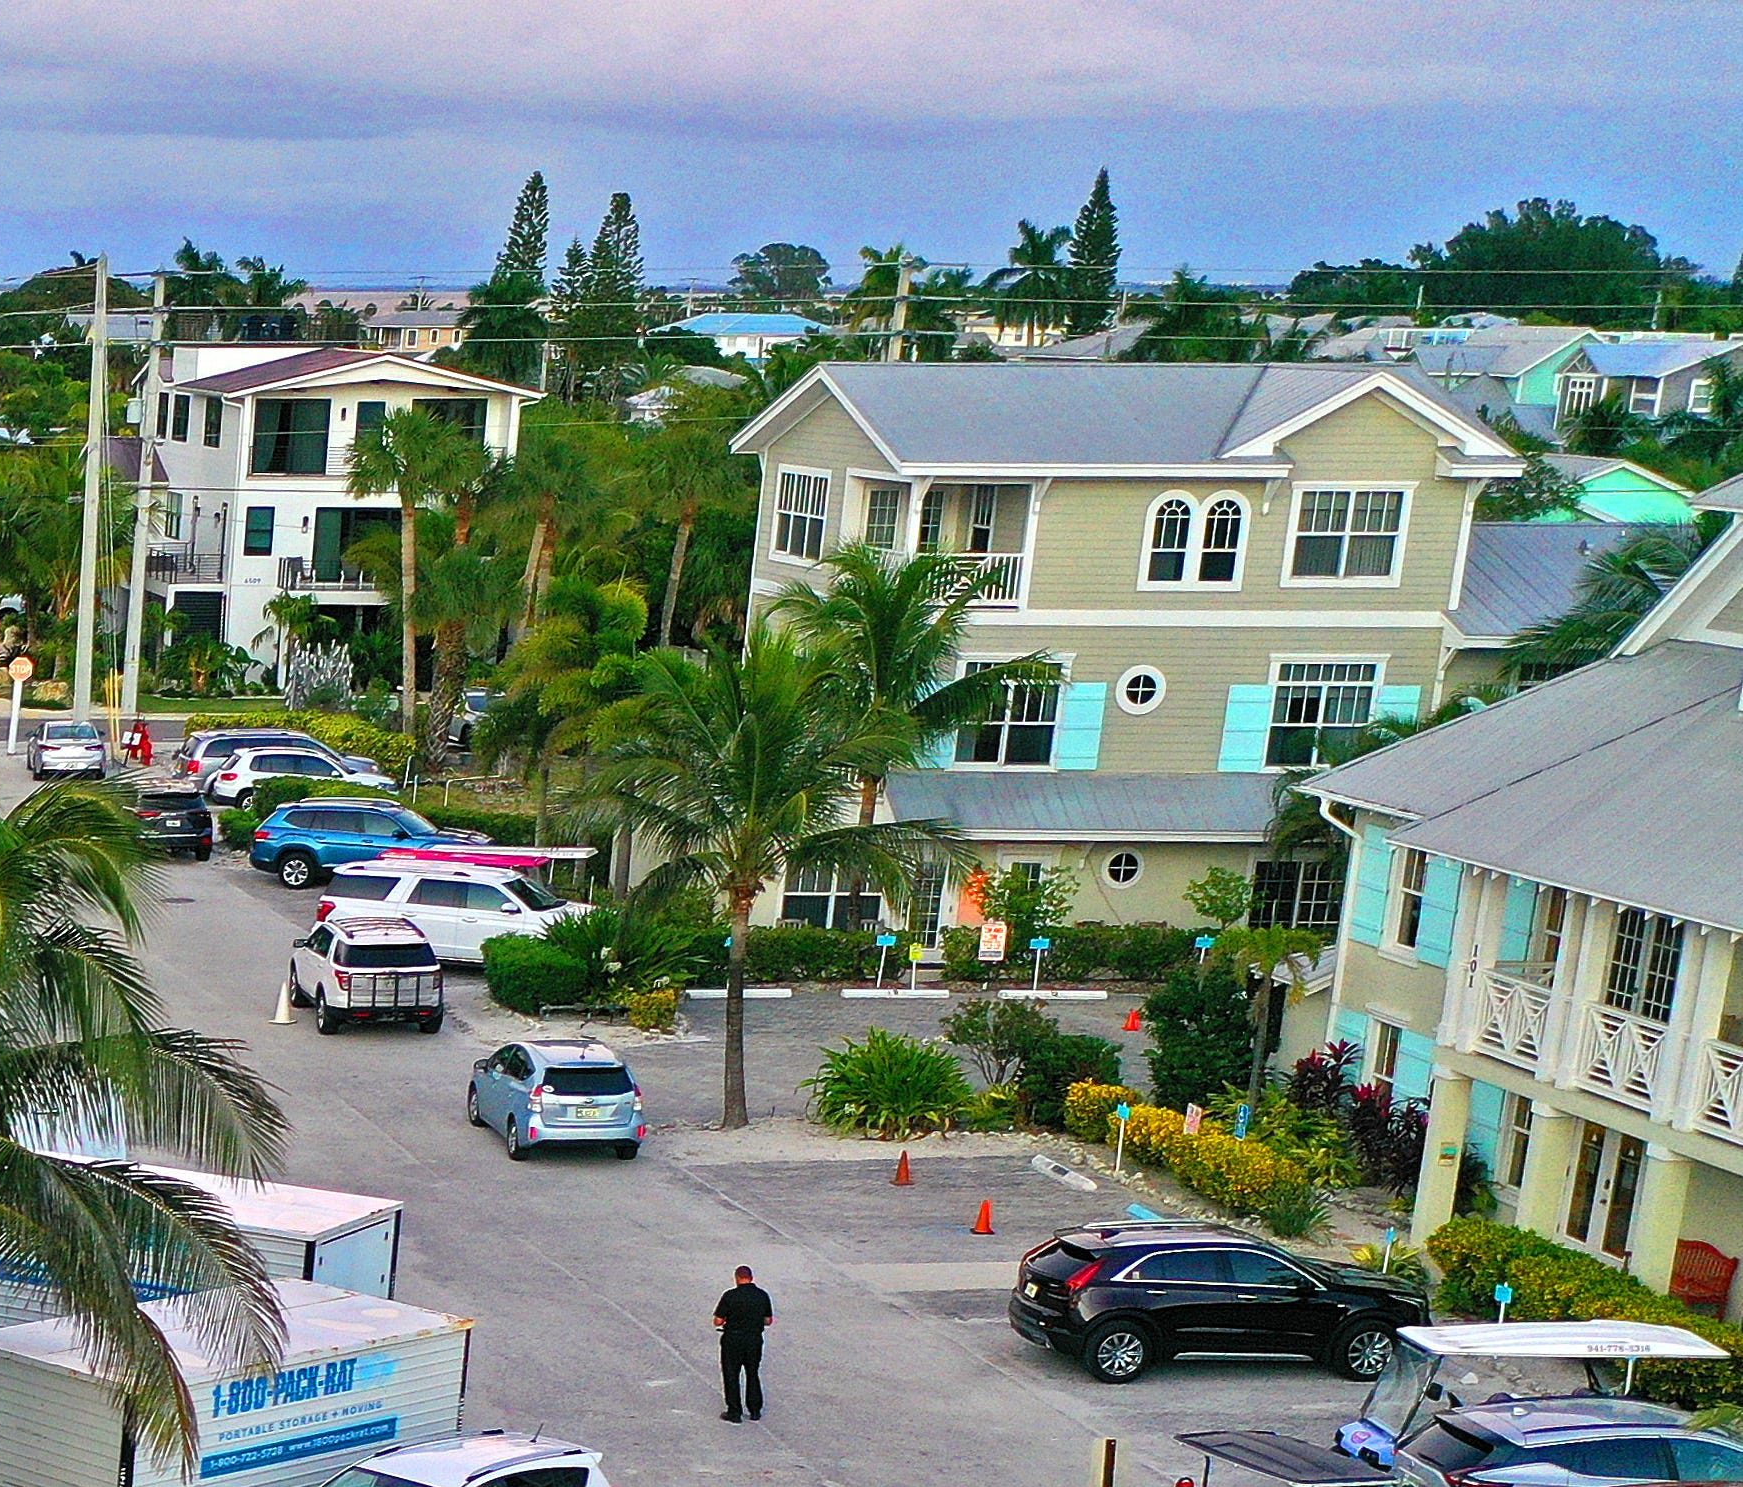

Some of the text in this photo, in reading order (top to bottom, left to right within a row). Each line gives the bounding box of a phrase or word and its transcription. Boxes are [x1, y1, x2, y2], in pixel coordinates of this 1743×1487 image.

[10, 664, 32, 674] STOP
[1469, 944, 1478, 988] 101
[213, 1357, 358, 1418] 1-800-PACK-RAT
[218, 1422, 274, 1441] PORTABLE
[279, 1411, 328, 1430] STORAGE
[341, 1400, 384, 1416] MOVING
